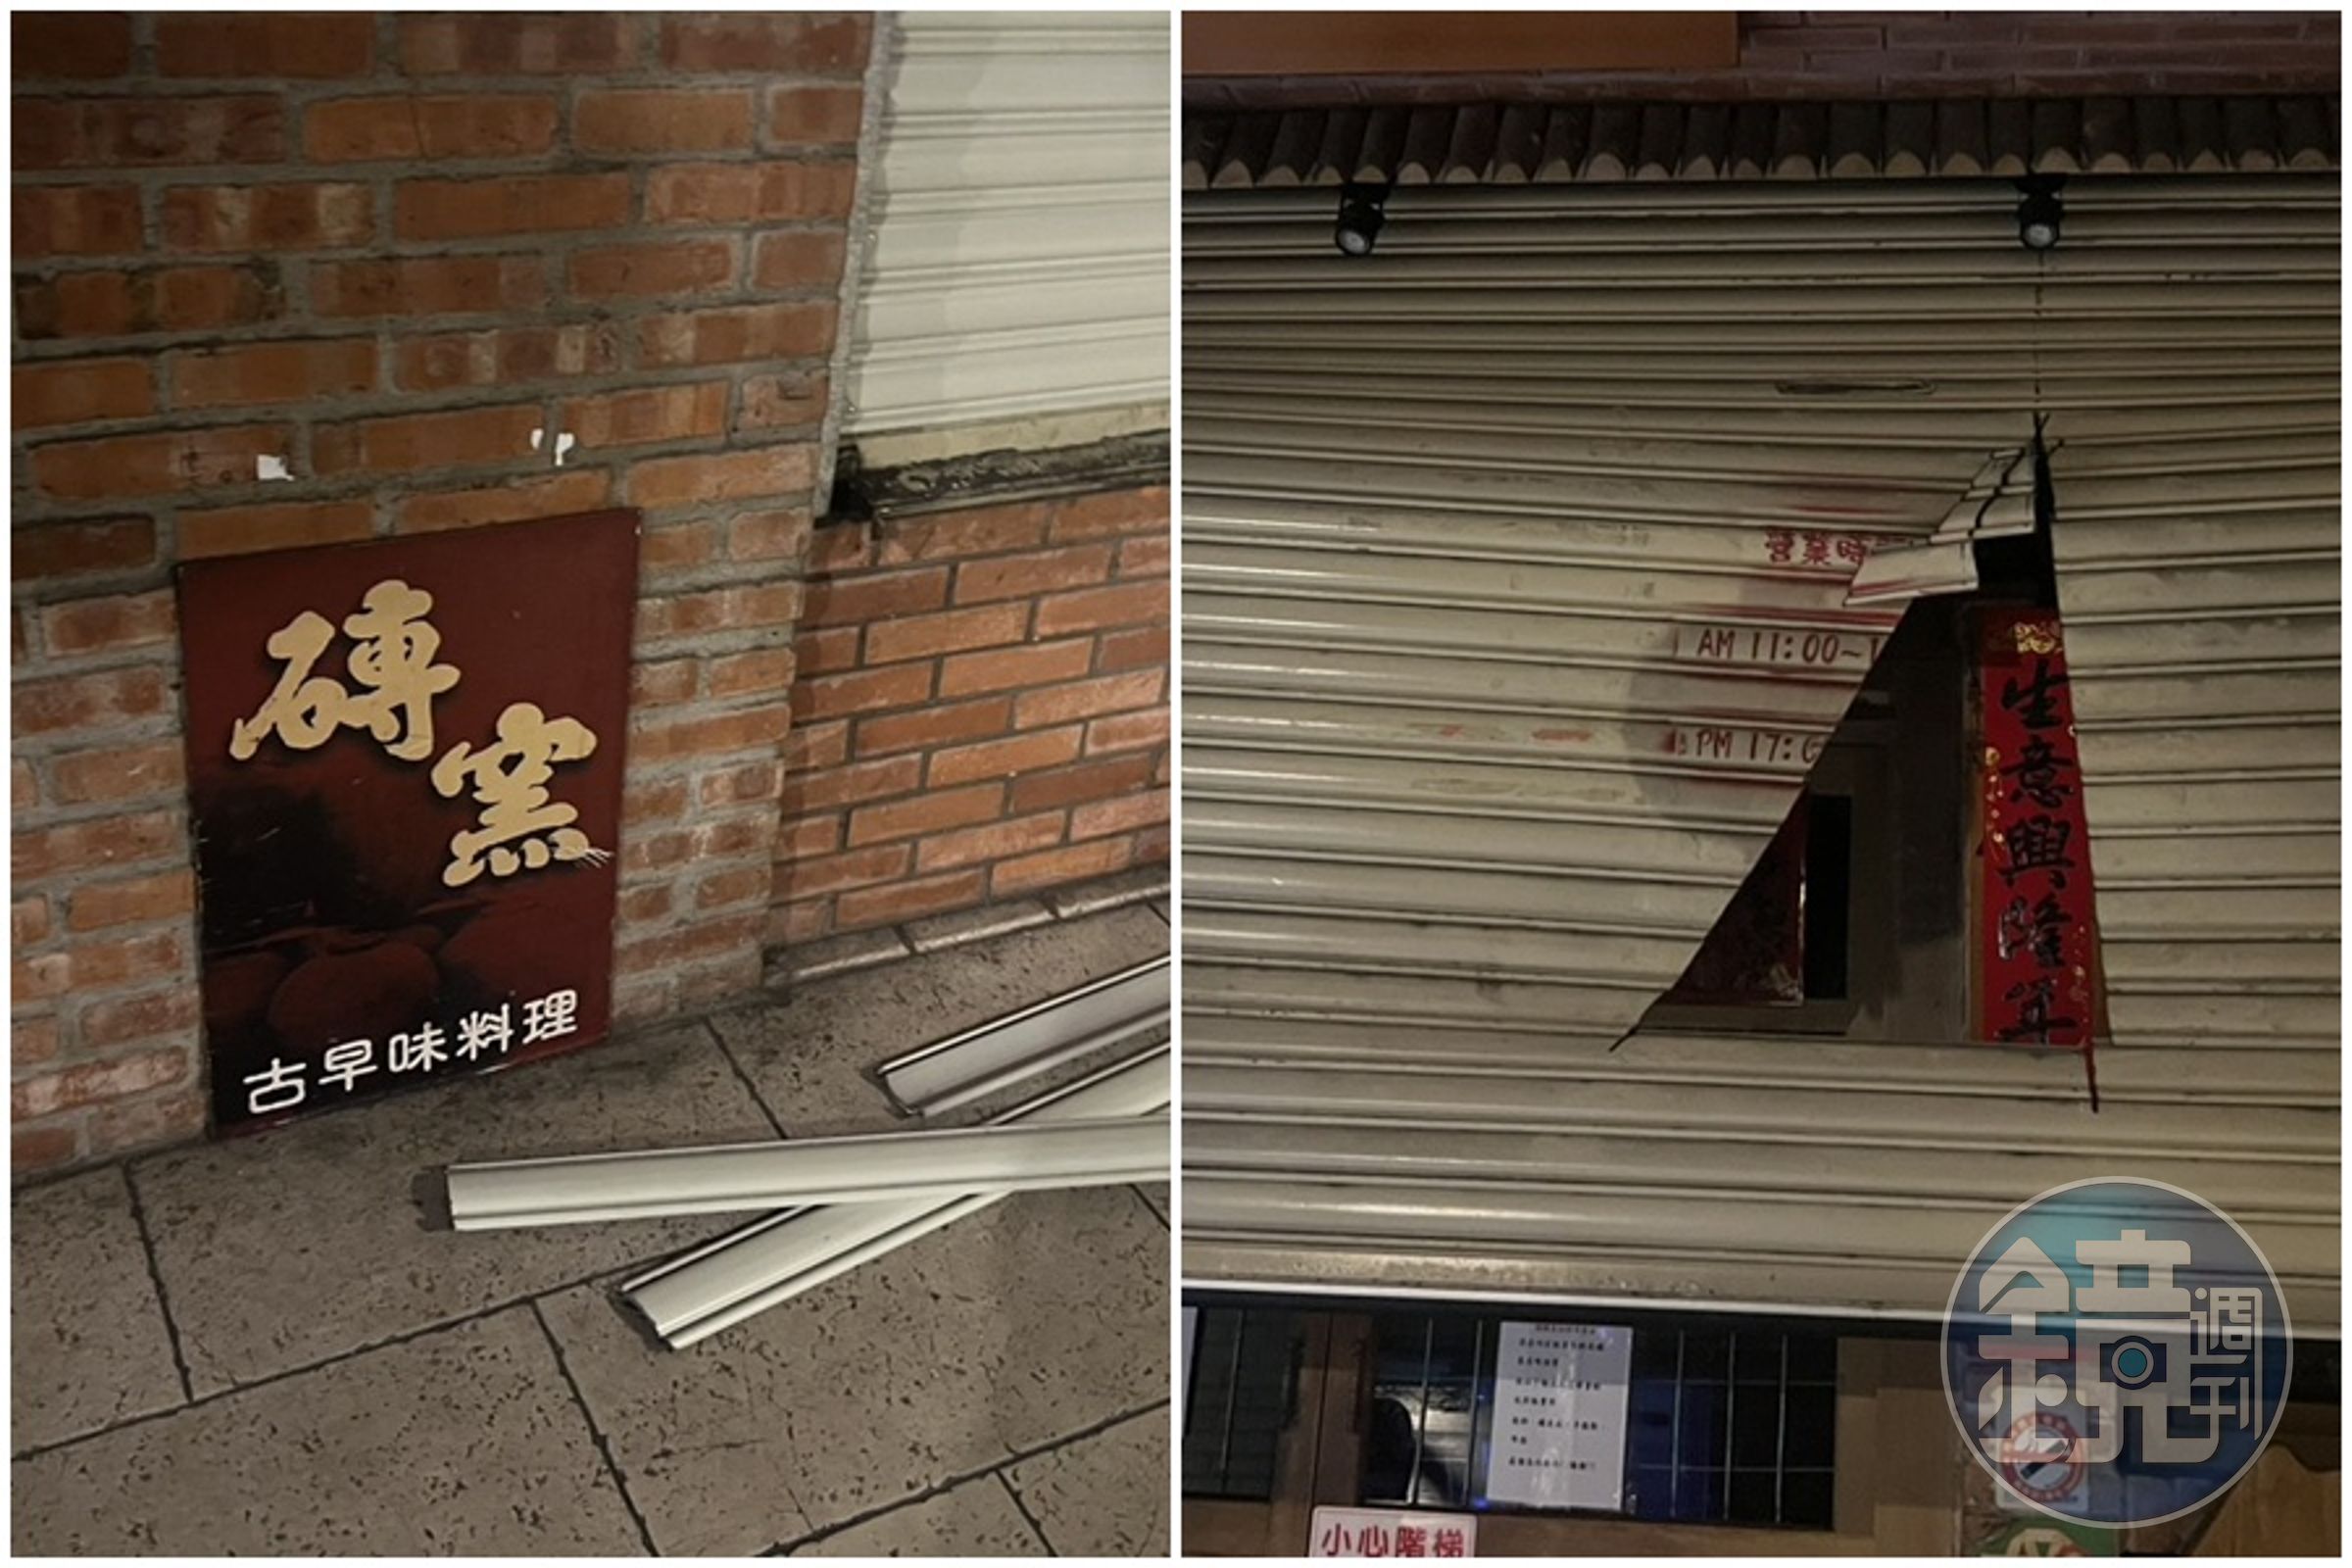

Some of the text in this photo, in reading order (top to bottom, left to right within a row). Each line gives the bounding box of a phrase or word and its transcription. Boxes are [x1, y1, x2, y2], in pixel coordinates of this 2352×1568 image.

[1765, 530, 1907, 565] 營業時
[1697, 629, 1735, 660] AM
[1695, 729, 1733, 759] PM
[243, 990, 578, 1113] 古早味料理
[1321, 1522, 1465, 1557] 小心階梯
